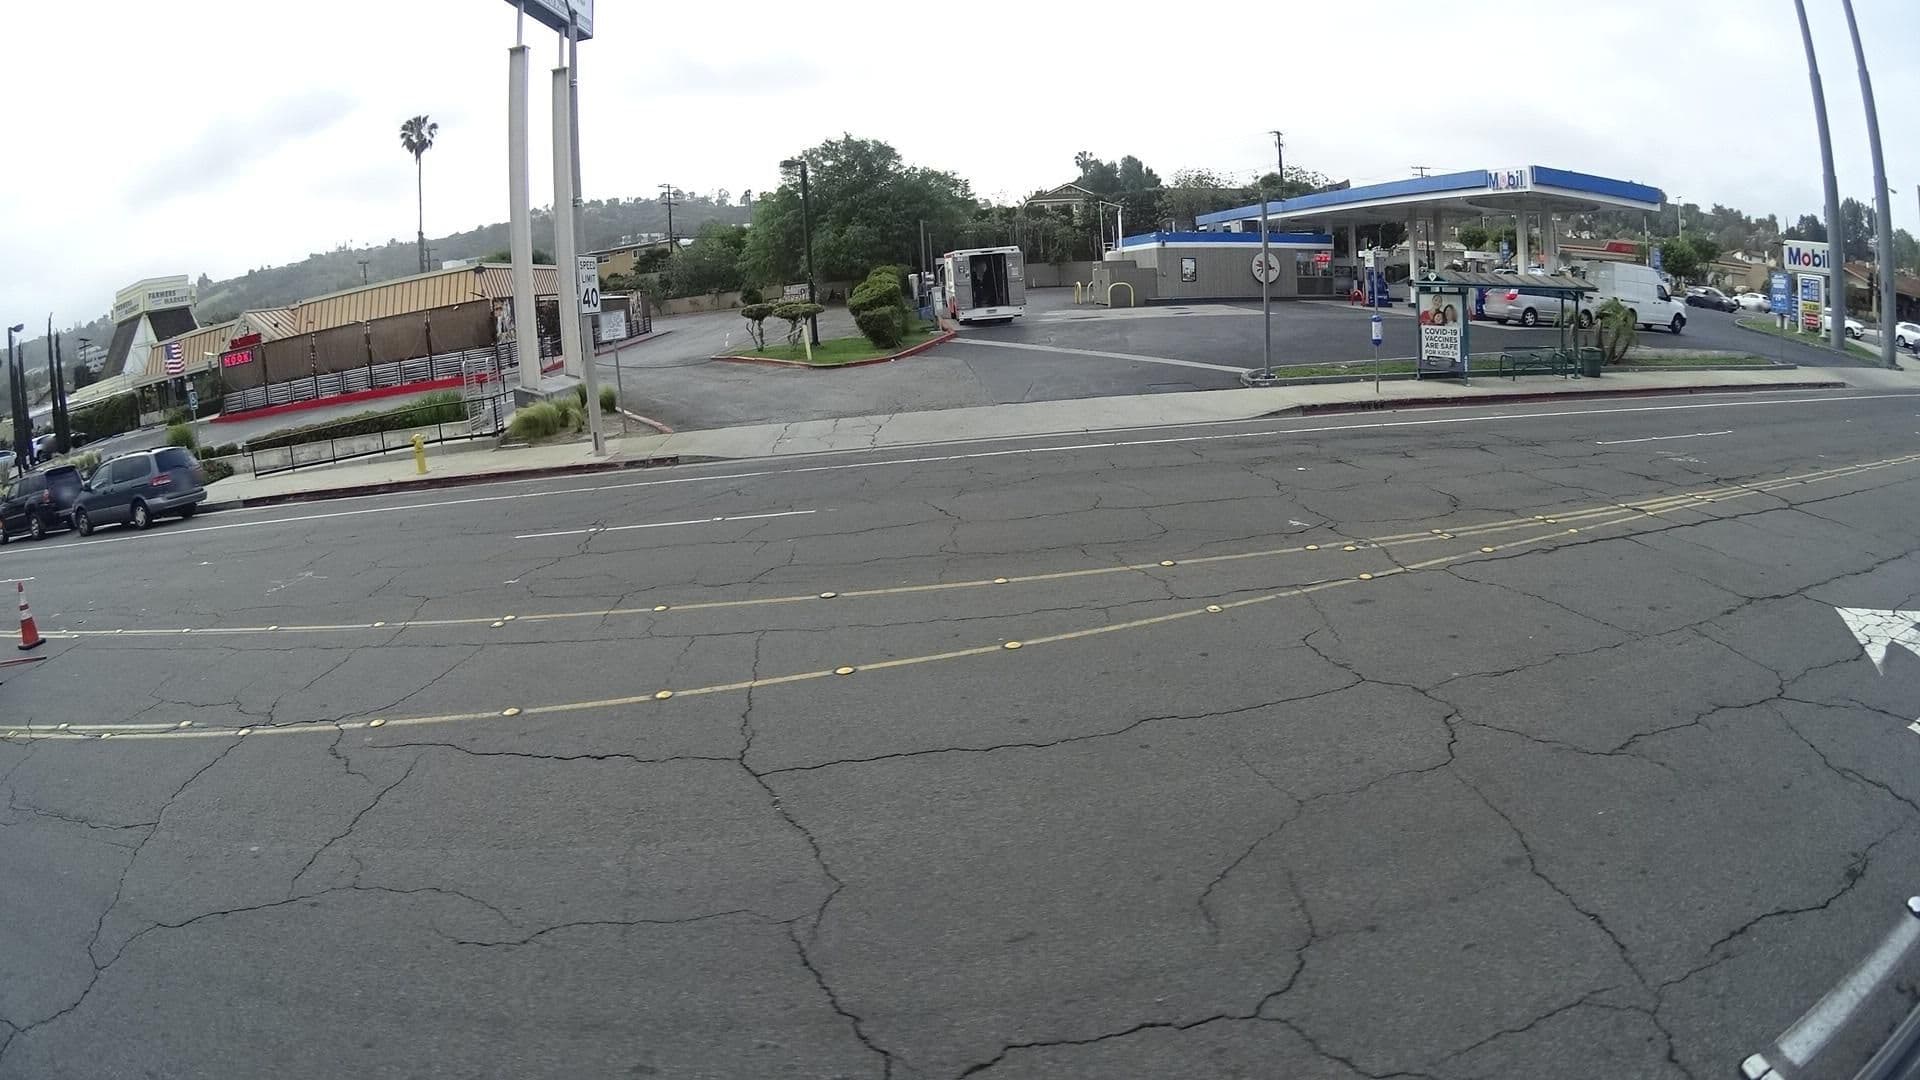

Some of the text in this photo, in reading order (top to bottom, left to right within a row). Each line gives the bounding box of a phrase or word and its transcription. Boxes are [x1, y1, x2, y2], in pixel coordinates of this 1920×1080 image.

[1488, 170, 1523, 188] Mobil
[1788, 247, 1830, 268] Mobil
[580, 261, 596, 270] SPEED
[582, 274, 595, 283] LIMIT
[148, 289, 177, 300] FARMERS
[583, 288, 598, 307] 40
[164, 295, 187, 305] MARKET
[1424, 335, 1458, 343] VACCINES
